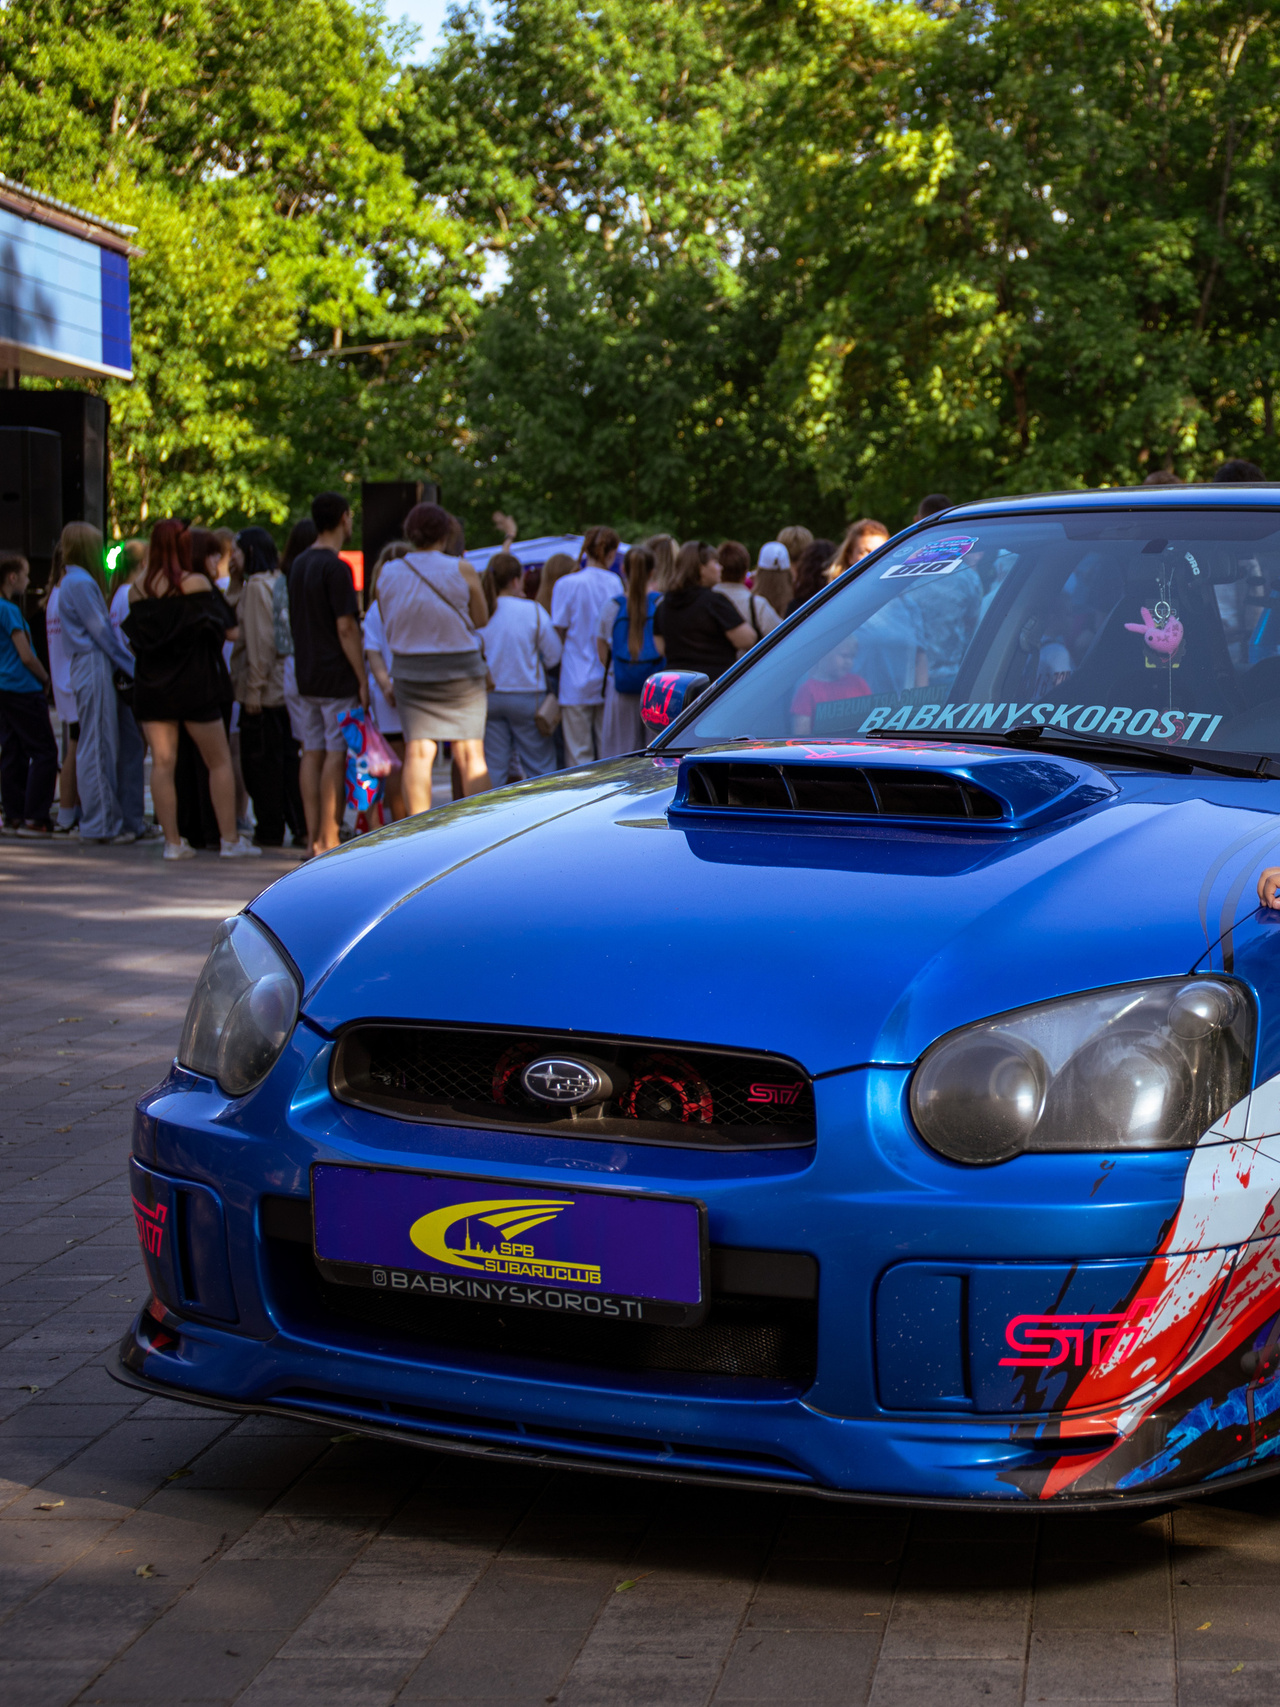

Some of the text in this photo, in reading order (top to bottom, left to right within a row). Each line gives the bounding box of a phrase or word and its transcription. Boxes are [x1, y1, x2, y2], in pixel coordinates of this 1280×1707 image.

[857, 703, 1222, 742] BABKINYSKOROSTI
[500, 1242, 534, 1257] SPB
[484, 1259, 601, 1284] SUBARUCLUB
[391, 1272, 643, 1319] BABKINYSKOROSTI
